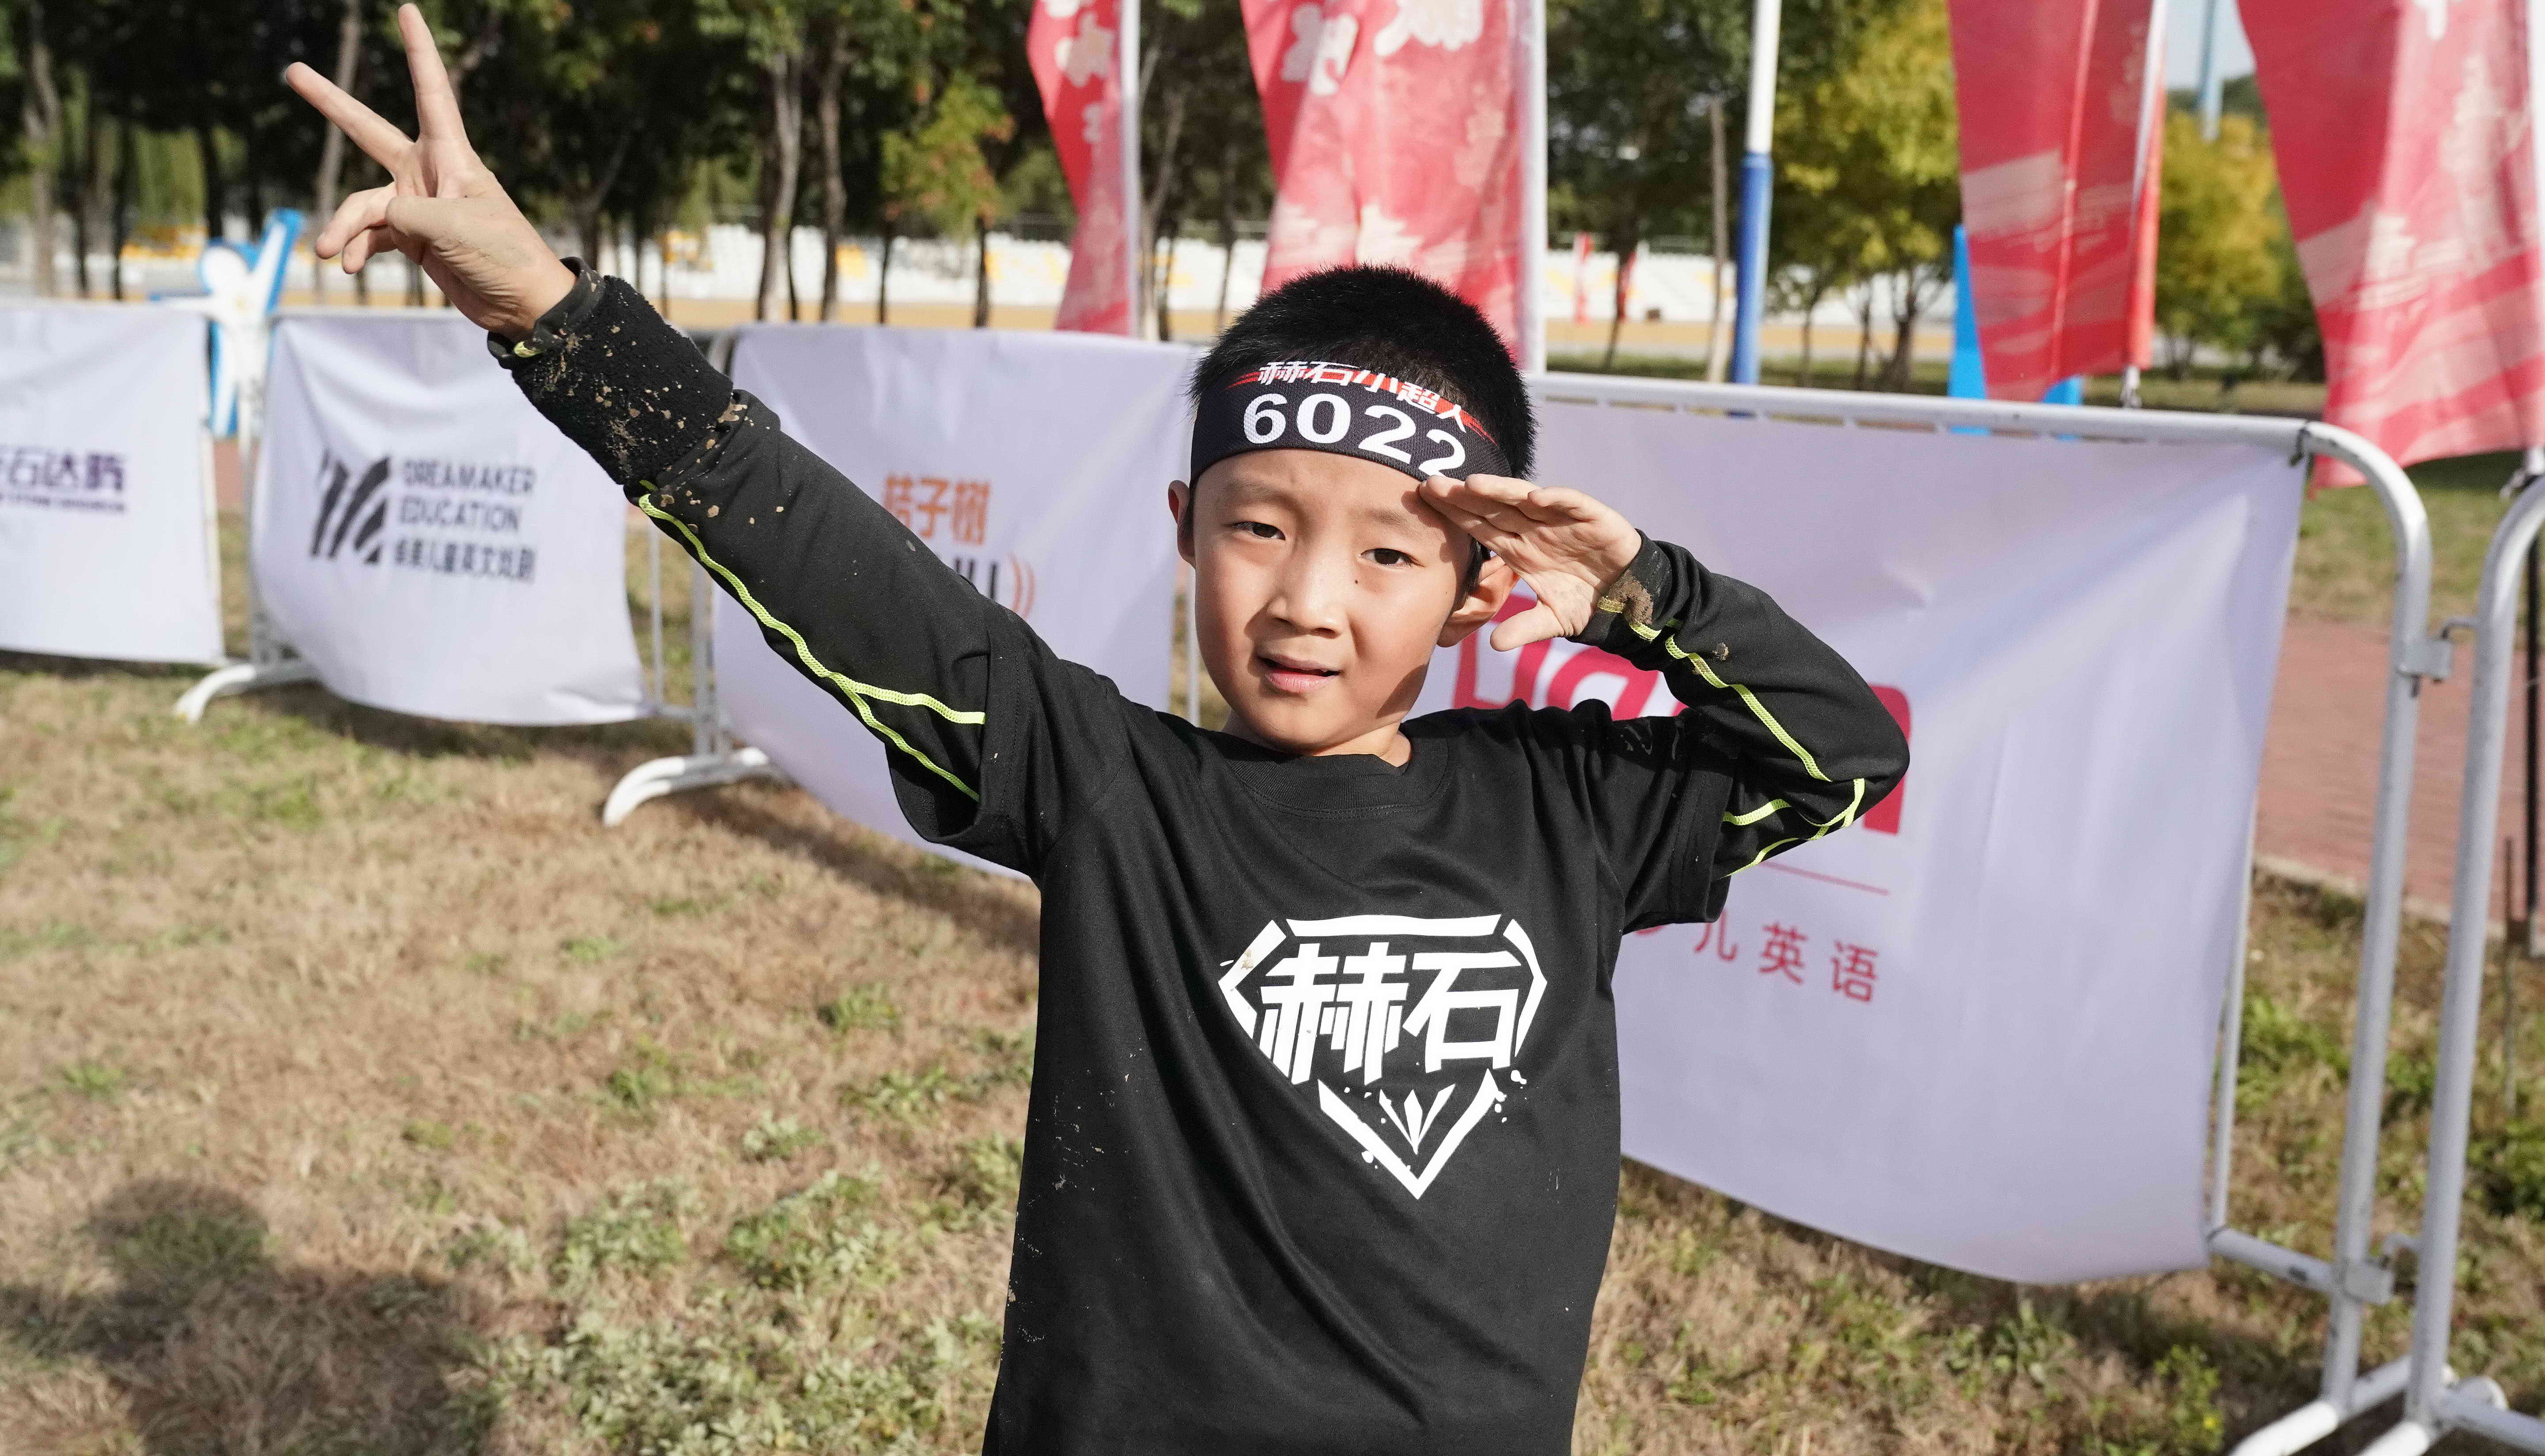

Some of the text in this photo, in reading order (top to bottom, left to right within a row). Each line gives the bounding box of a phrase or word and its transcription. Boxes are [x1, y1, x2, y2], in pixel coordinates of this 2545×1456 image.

[1243, 392, 1466, 477] 6022
[1257, 360, 1467, 433] 赫石小超人
[399, 494, 521, 534] EDUCATION
[1259, 941, 1522, 1086] 赫石
